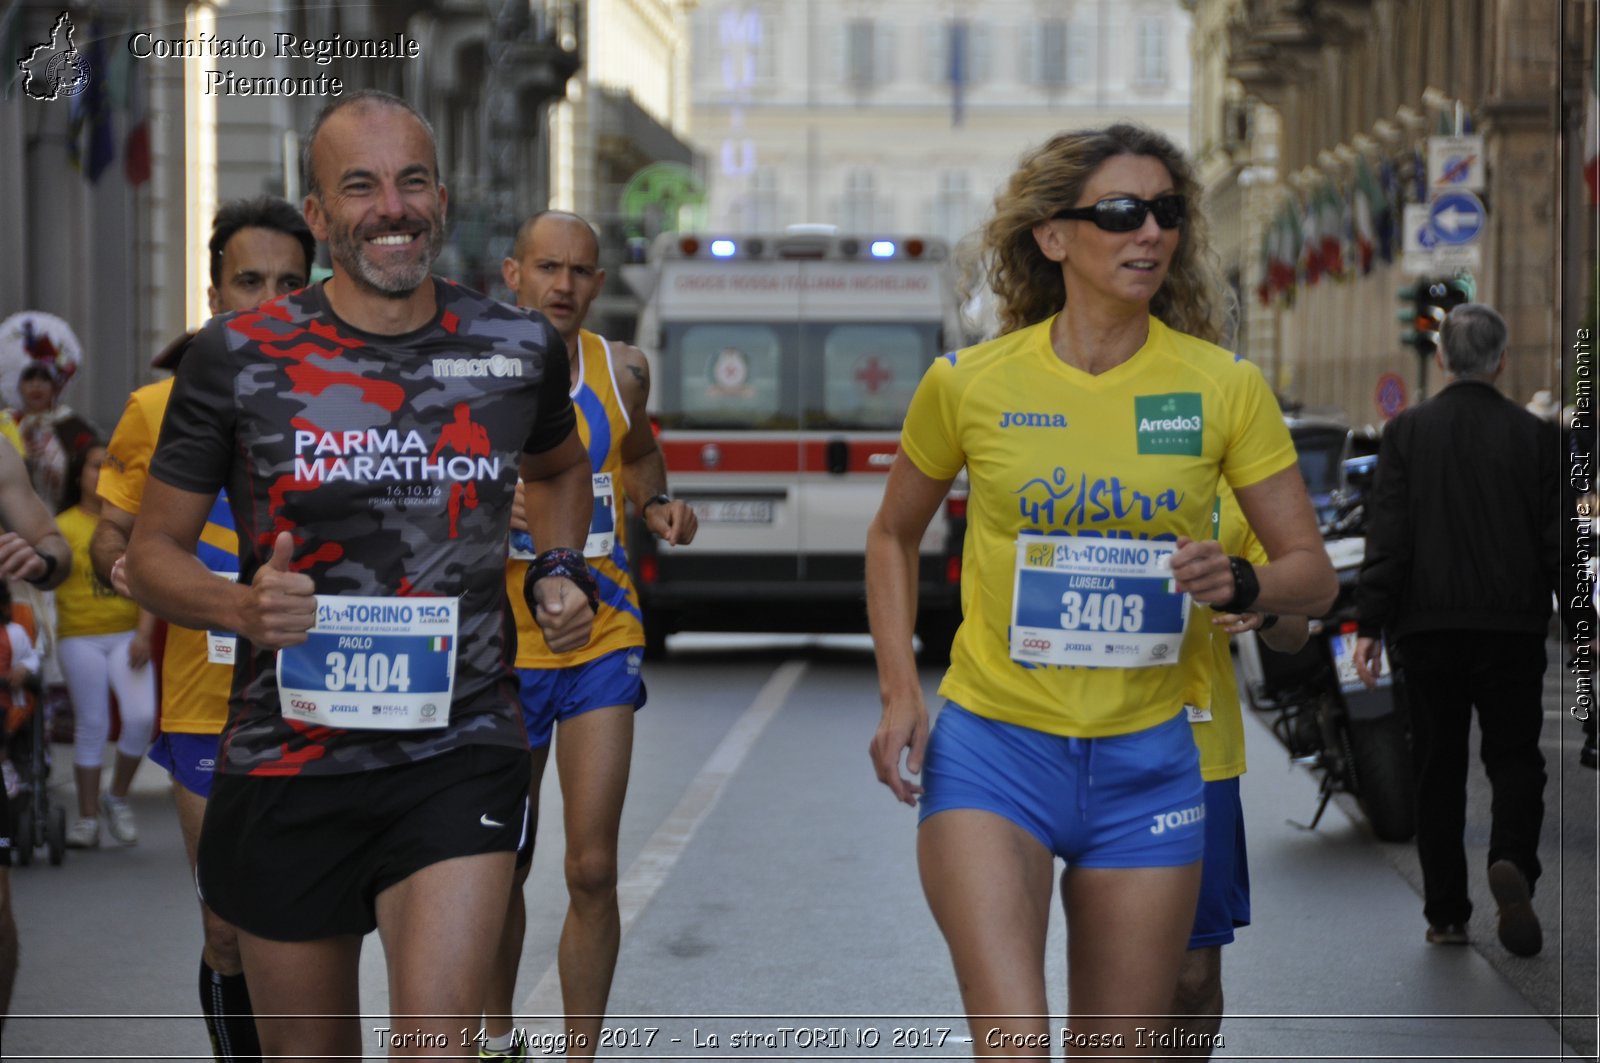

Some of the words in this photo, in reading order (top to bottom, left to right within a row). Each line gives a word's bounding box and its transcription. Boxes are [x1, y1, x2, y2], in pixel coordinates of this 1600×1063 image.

[432, 354, 523, 378] macron
[1138, 415, 1201, 433] Arredo3
[294, 428, 429, 456] PARMA
[293, 455, 500, 482] MARATHON
[385, 484, 442, 497] 16.10.16
[1068, 575, 1116, 590] LUISELLA
[1060, 590, 1145, 633] 3403
[338, 635, 373, 650] PAOLO
[1022, 638, 1052, 652] coop
[325, 651, 411, 693] 3404
[290, 699, 317, 713] coop
